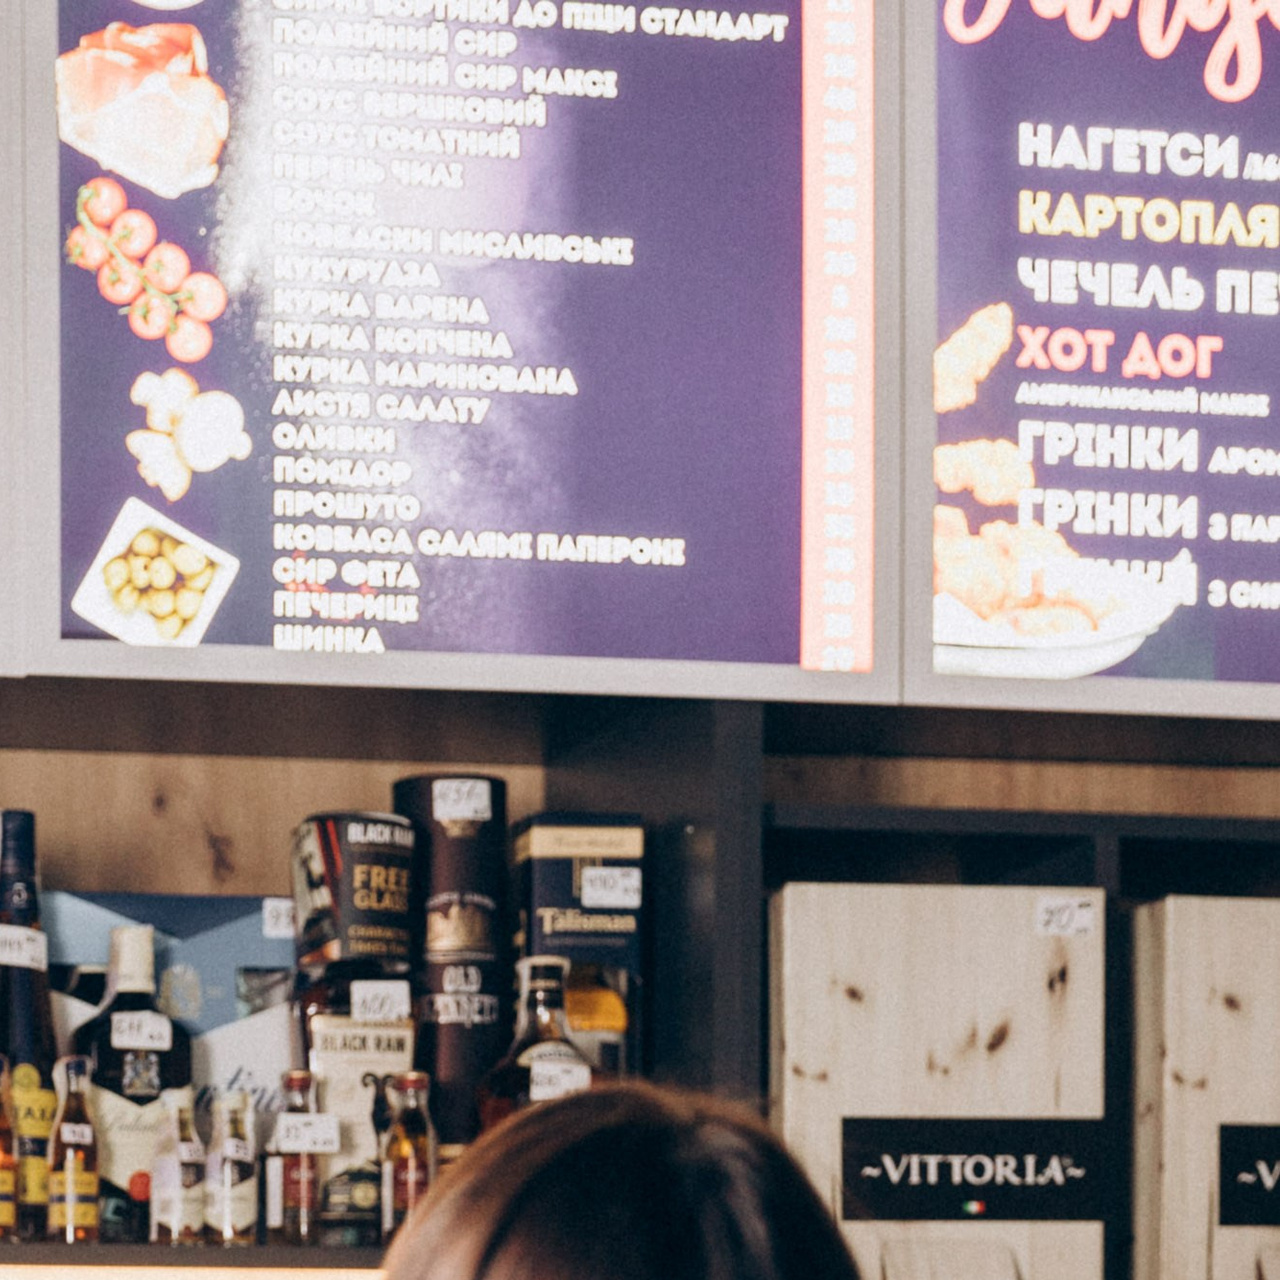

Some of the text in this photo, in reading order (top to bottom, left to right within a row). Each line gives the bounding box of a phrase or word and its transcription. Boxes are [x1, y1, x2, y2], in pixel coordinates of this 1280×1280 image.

[511, 0, 558, 30] ДО
[639, 5, 789, 44] СТАНДАРТ
[453, 27, 518, 59] СИР
[452, 61, 518, 92] СИР
[521, 64, 618, 99] МАКСІ
[272, 84, 547, 127] СОУС ВЕРШКОВИЙ
[272, 118, 521, 159] СОУС ТОМАТНИЙ
[1017, 120, 1240, 180] НАГЕТСИ
[1018, 189, 1280, 248] КАРТОПЛЯ
[273, 253, 441, 289] КУКУРУДЗА
[1016, 256, 1280, 316] ЧЕЧЕЛЬ ПЕ
[273, 288, 490, 325] КУРКА ВАРЕНА
[273, 320, 513, 359] КУРКА КОПЧЕНА
[1015, 324, 1224, 380] ХОТ ДОГ
[273, 353, 578, 396] КУРКА МАРИНОВАНА
[270, 386, 491, 426] ЛИСТЯ САЛАТУ
[271, 421, 396, 454] ОЛИВКИ
[1017, 419, 1199, 473] ГРІНКИ
[272, 454, 412, 490] ПОМІДОР
[272, 488, 421, 522] ПРОШУТО
[1017, 487, 1198, 540] ГРІНКИ
[272, 521, 414, 556] КОВБАСА
[536, 532, 686, 567] ПАПЕРОНІ
[271, 556, 420, 589] СИР ФЕТА
[272, 589, 419, 624] ПЕЧЕРИЦІ
[272, 623, 386, 654] ШИНКА
[347, 822, 392, 845] BLACK
[536, 906, 637, 935] Talisman
[322, 1034, 369, 1053] BLACK
